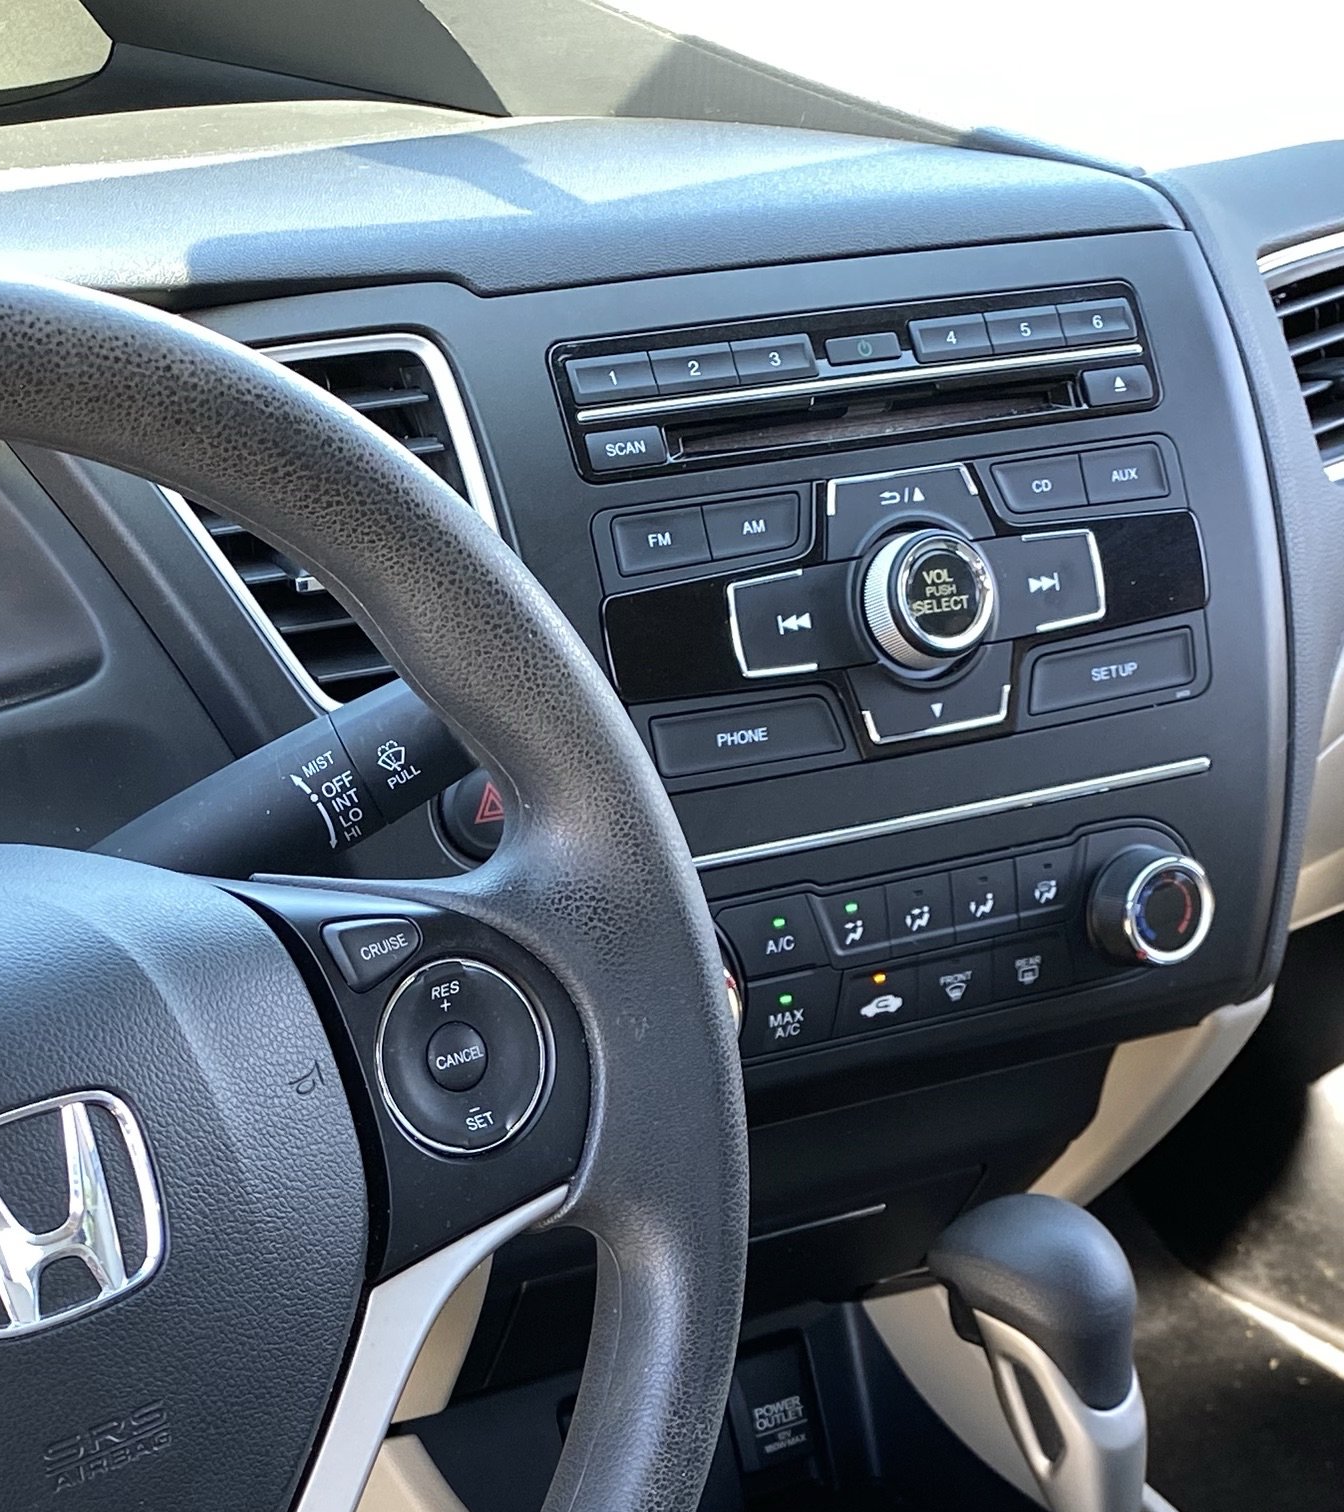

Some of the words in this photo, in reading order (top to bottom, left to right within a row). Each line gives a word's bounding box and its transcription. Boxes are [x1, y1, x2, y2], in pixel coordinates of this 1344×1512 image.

[1020, 322, 1032, 337] 5
[1092, 314, 1104, 329] 6
[946, 330, 957, 345] 4
[687, 360, 701, 377] 2
[768, 352, 782, 367] 3
[608, 370, 618, 386] 1
[605, 439, 646, 458] SCAN
[1111, 467, 1139, 482] AUX
[1031, 479, 1052, 493] CD
[742, 519, 766, 535] AM
[647, 532, 672, 548] FM
[922, 568, 954, 584] VOL
[925, 584, 957, 597] PUSH
[911, 595, 970, 616] SELECT
[1091, 662, 1138, 681] SETUP
[716, 727, 769, 748] PHONE
[301, 750, 335, 778] MIST
[321, 770, 354, 798] OFF
[387, 764, 422, 790] PULL
[331, 787, 360, 813] INT
[339, 806, 364, 828] LO
[343, 825, 363, 842] HI
[360, 933, 409, 961] CRUISE
[766, 936, 796, 955] A/C
[431, 980, 461, 1000] RES
[769, 1009, 804, 1028] MAX
[775, 1024, 802, 1040] A/C
[435, 1046, 485, 1070] CANCEL
[465, 1111, 496, 1132] SET
[754, 1395, 801, 1419] POWER
[756, 1405, 805, 1430] OUTLET
[43, 1400, 168, 1477] SRS
[55, 1431, 173, 1494] AIRBAG
